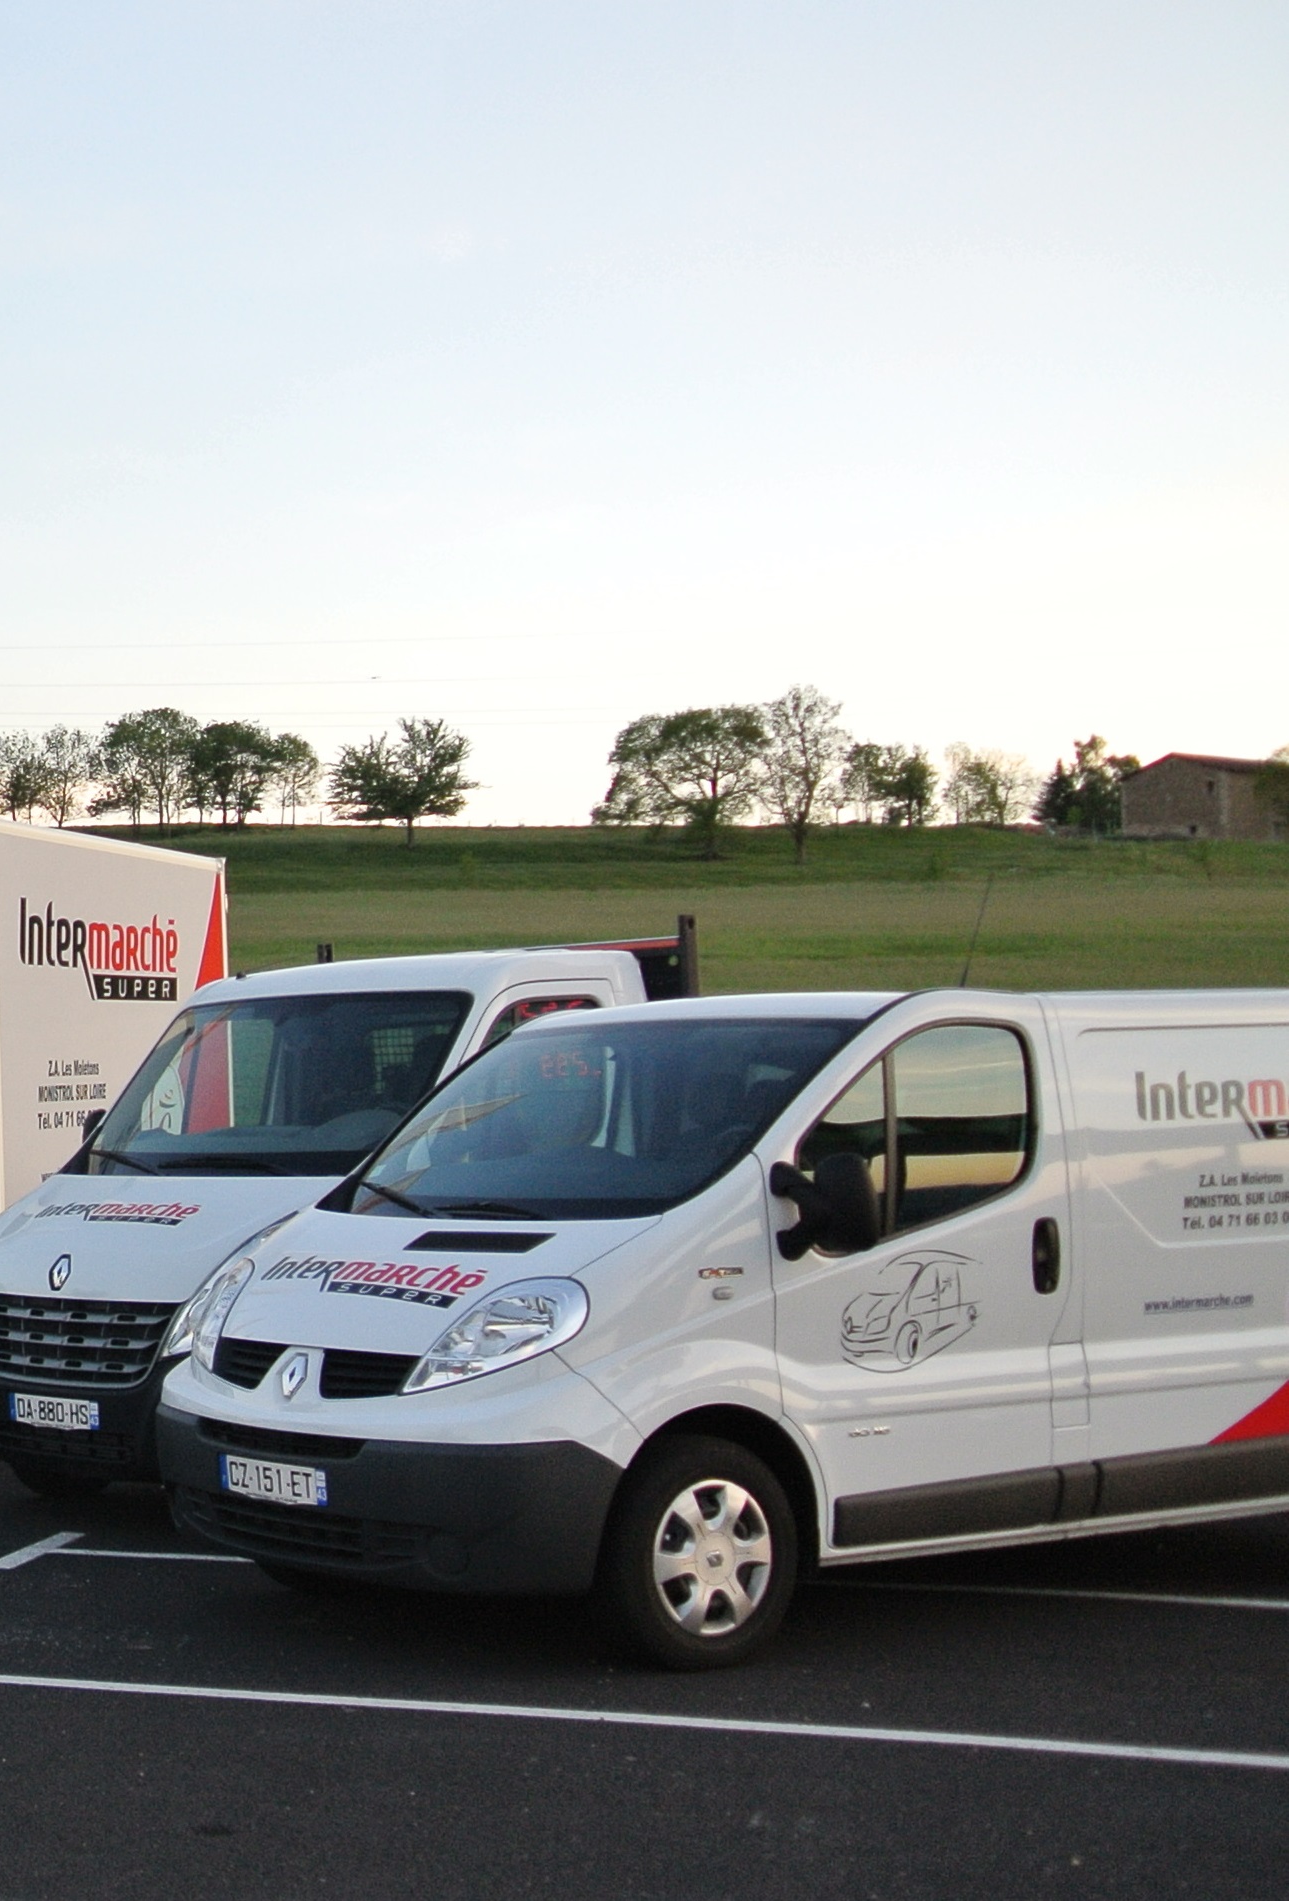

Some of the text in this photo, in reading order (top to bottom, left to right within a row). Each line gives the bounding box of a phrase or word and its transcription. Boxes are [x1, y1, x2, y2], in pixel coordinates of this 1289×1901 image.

[103, 977, 171, 998] SUPER
[62, 1060, 72, 1076] Les
[38, 1082, 106, 1102] MONISTROL SUR LOIRE
[54, 1111, 63, 1128] 04
[65, 1110, 74, 1127] 71
[1221, 1173, 1238, 1186] Les
[1183, 1193, 1242, 1209] MONISTROL
[1245, 1191, 1266, 1205] SUR
[1208, 1214, 1223, 1228] 04
[1227, 1212, 1241, 1227] 71
[1245, 1211, 1261, 1226] 66
[1264, 1210, 1279, 1225] 03
[337, 1283, 442, 1305] SUPER
[1144, 1292, 1254, 1313] www.intermarche.com
[17, 1398, 89, 1425] DA-880-HS
[229, 1460, 312, 1499] CZ-151-ET
